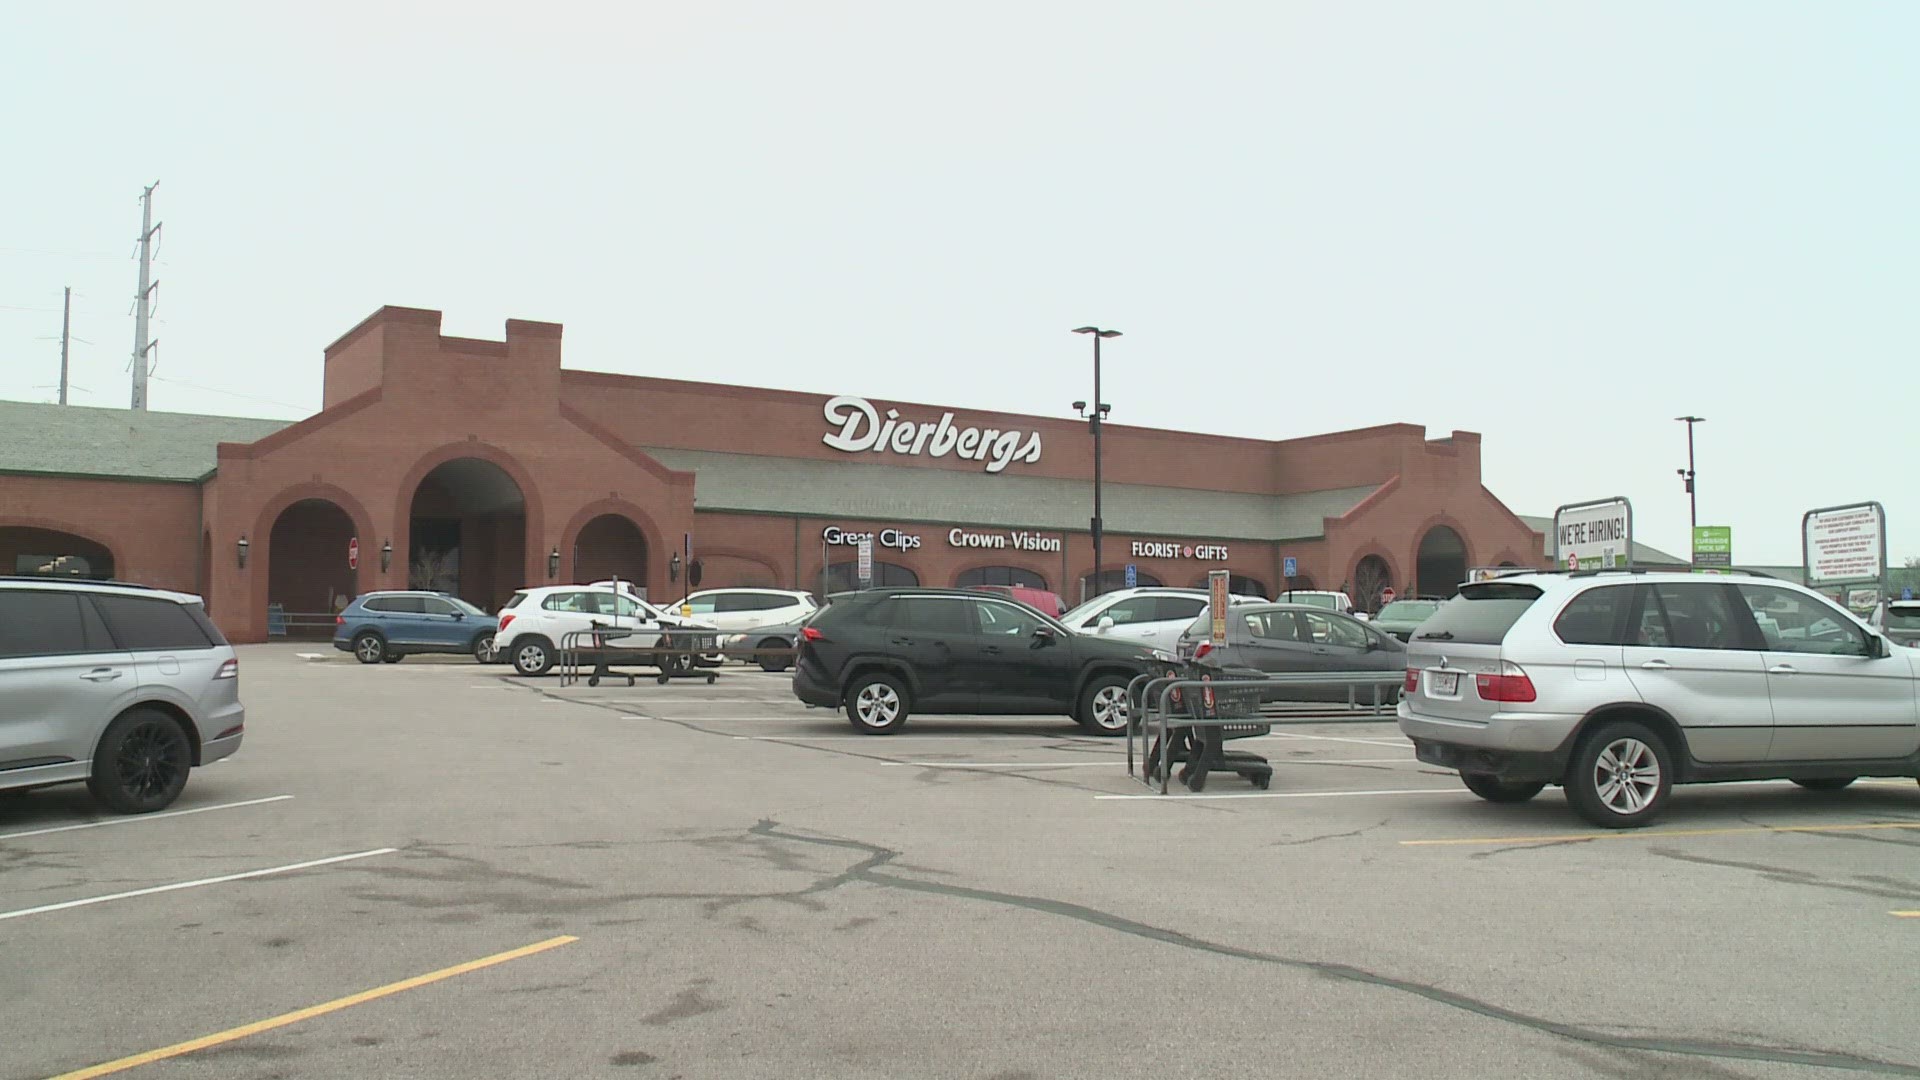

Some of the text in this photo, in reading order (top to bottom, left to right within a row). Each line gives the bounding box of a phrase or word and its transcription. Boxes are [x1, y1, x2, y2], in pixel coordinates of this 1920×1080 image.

[822, 396, 1042, 472] Dierbergs
[880, 529, 921, 552] Clips
[949, 528, 1061, 551] Crown Vision
[1560, 517, 1624, 546] WE'RE HIRING!
[1132, 542, 1228, 560] FLORIST GIFTS
